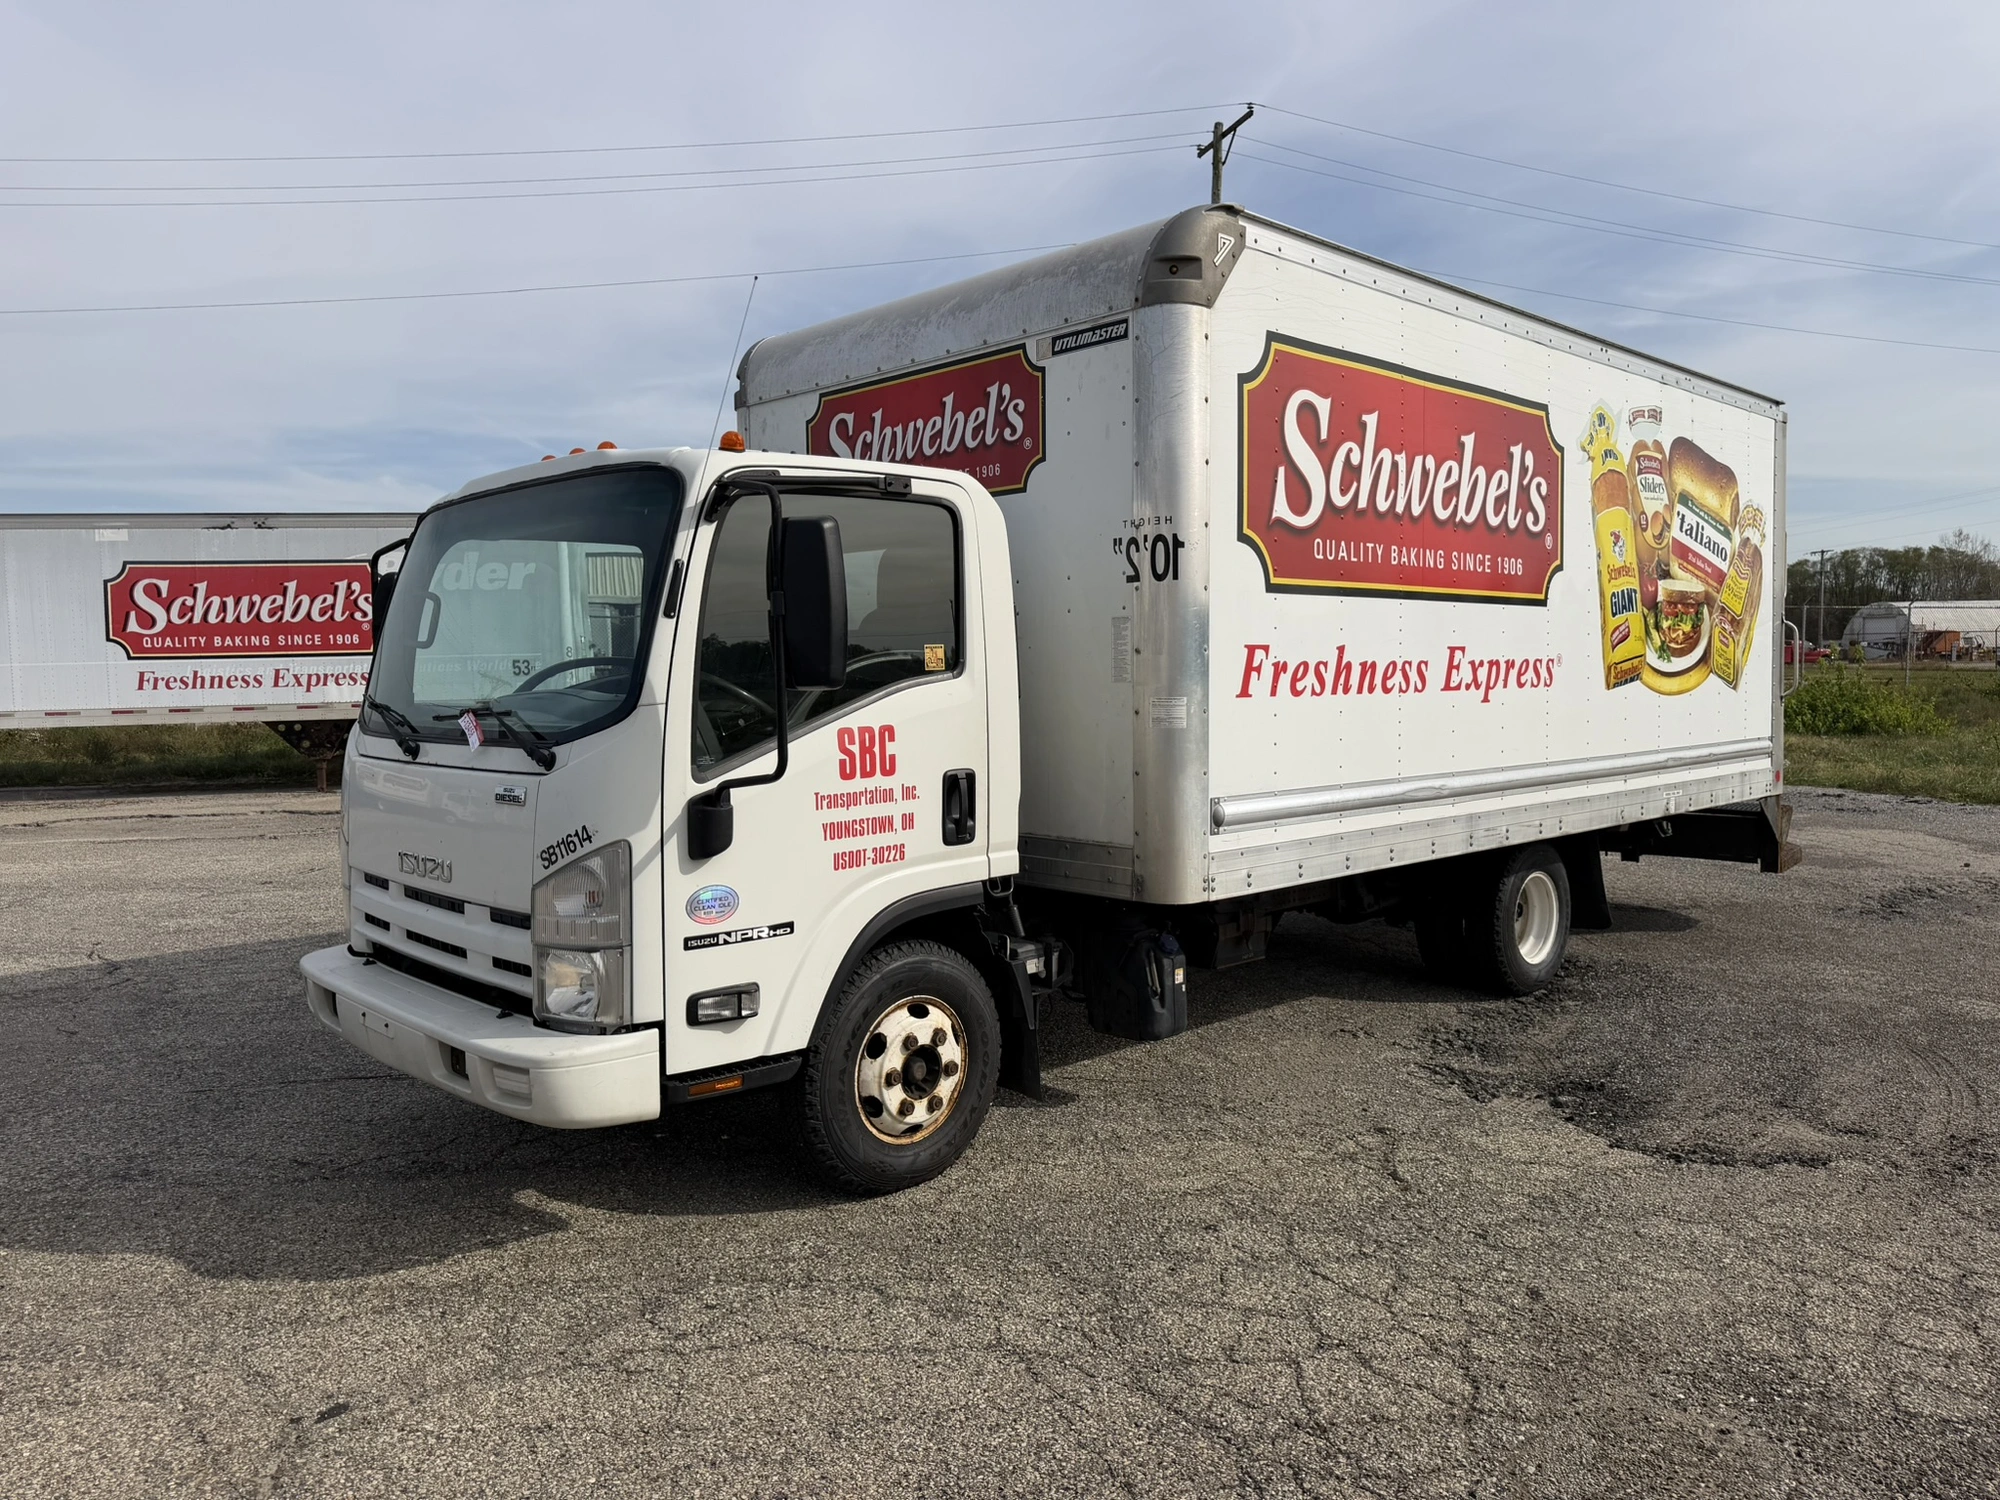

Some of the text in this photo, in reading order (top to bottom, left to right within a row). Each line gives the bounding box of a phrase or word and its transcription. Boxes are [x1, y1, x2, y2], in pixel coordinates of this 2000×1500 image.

[1054, 323, 1127, 352] UTILIMASTER
[976, 463, 1001, 479] 1906
[1270, 389, 1548, 532] Schwebel's
[1639, 477, 1665, 495] Sliders
[1313, 538, 1523, 576] QUALITY BAKING SINCE 1906
[126, 578, 372, 634] Schwebel's
[1610, 588, 1638, 618] GIANT
[143, 634, 359, 648] QUALITY BAKING SINCE 1906
[136, 667, 370, 691] Freshness Express
[512, 659, 530, 676] 53
[1236, 644, 1555, 703] Freshness Express
[837, 724, 896, 781] SBC
[495, 793, 522, 803] DIESEL
[814, 784, 920, 811] Transportation, Inc.
[822, 813, 914, 842] YOUNGSTOWN, OH
[540, 825, 593, 870] SB11614
[833, 844, 905, 871] USDOT-30226
[398, 850, 453, 883] ISUZU
[688, 926, 791, 947] ISUZU NPR HD
